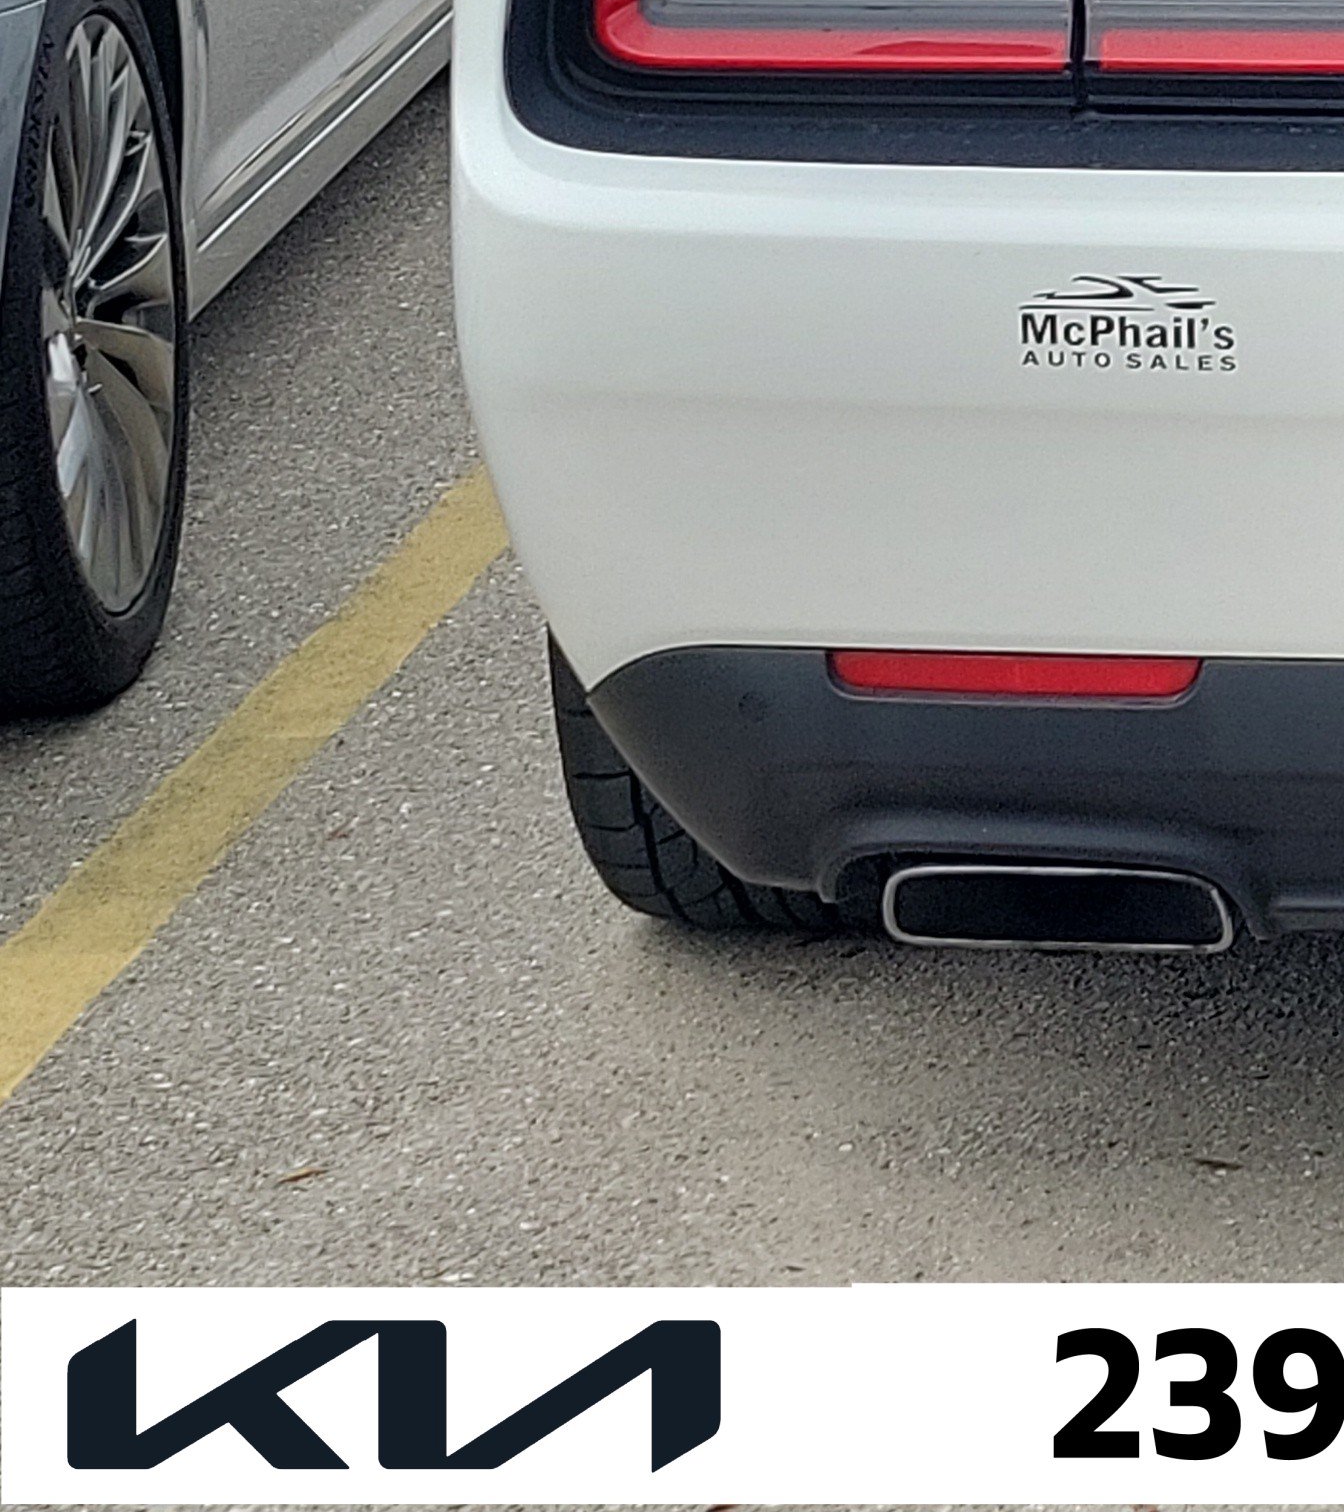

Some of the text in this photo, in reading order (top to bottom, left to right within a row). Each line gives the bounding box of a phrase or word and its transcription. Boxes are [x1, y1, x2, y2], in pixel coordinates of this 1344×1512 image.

[1021, 312, 1235, 350] McPhail's
[1021, 350, 1237, 372] AUTO SALES
